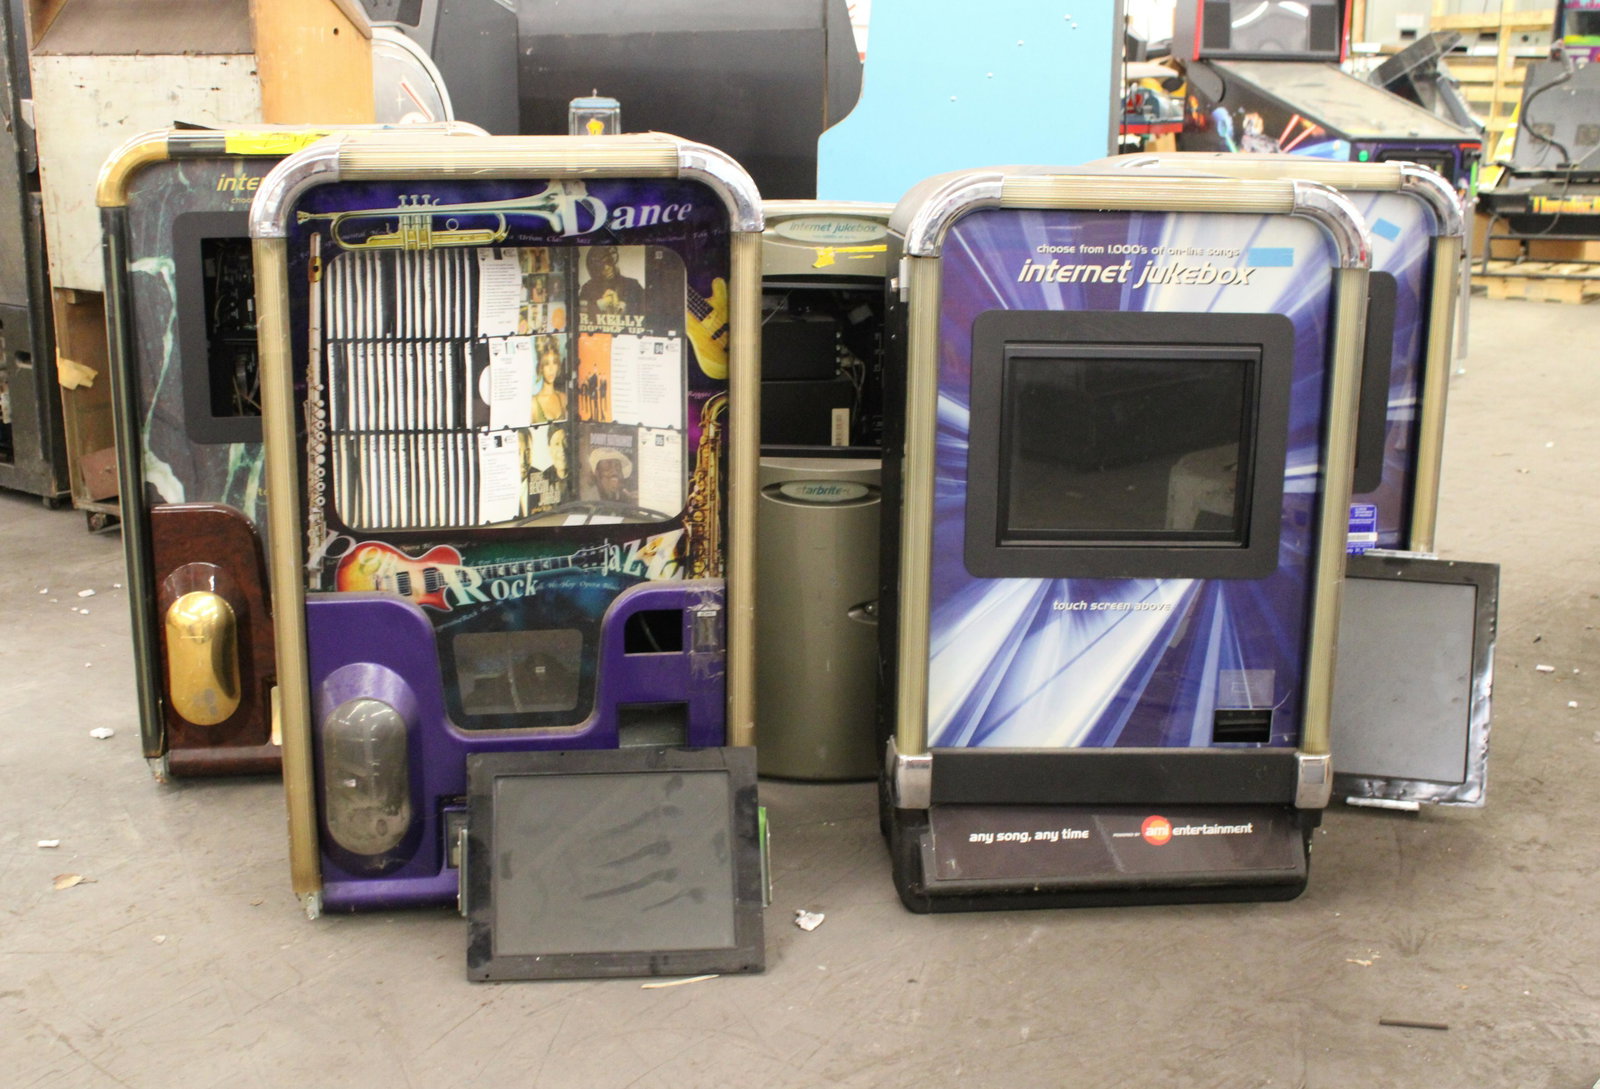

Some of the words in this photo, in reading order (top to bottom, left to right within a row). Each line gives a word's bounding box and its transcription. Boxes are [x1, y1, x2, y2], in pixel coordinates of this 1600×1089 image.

[559, 195, 693, 239] Dance
[832, 221, 878, 234] jukebox
[1036, 243, 1076, 255] choose
[1079, 243, 1105, 255] from
[1151, 244, 1164, 256] of
[1168, 245, 1204, 257] on-line
[1207, 247, 1240, 258] songs
[1017, 258, 1133, 285] internet
[1132, 260, 1257, 290] jukebox
[596, 314, 645, 327] KELLY
[428, 563, 538, 606] Rock
[1053, 599, 1088, 611] touch
[1090, 601, 1131, 611] screen
[1133, 600, 1171, 611] above
[969, 832, 994, 844] any
[996, 831, 1032, 843] song,
[1034, 830, 1060, 843] any
[1061, 828, 1090, 840] time
[1145, 823, 1170, 836] ami
[1172, 822, 1254, 836] entertainment
